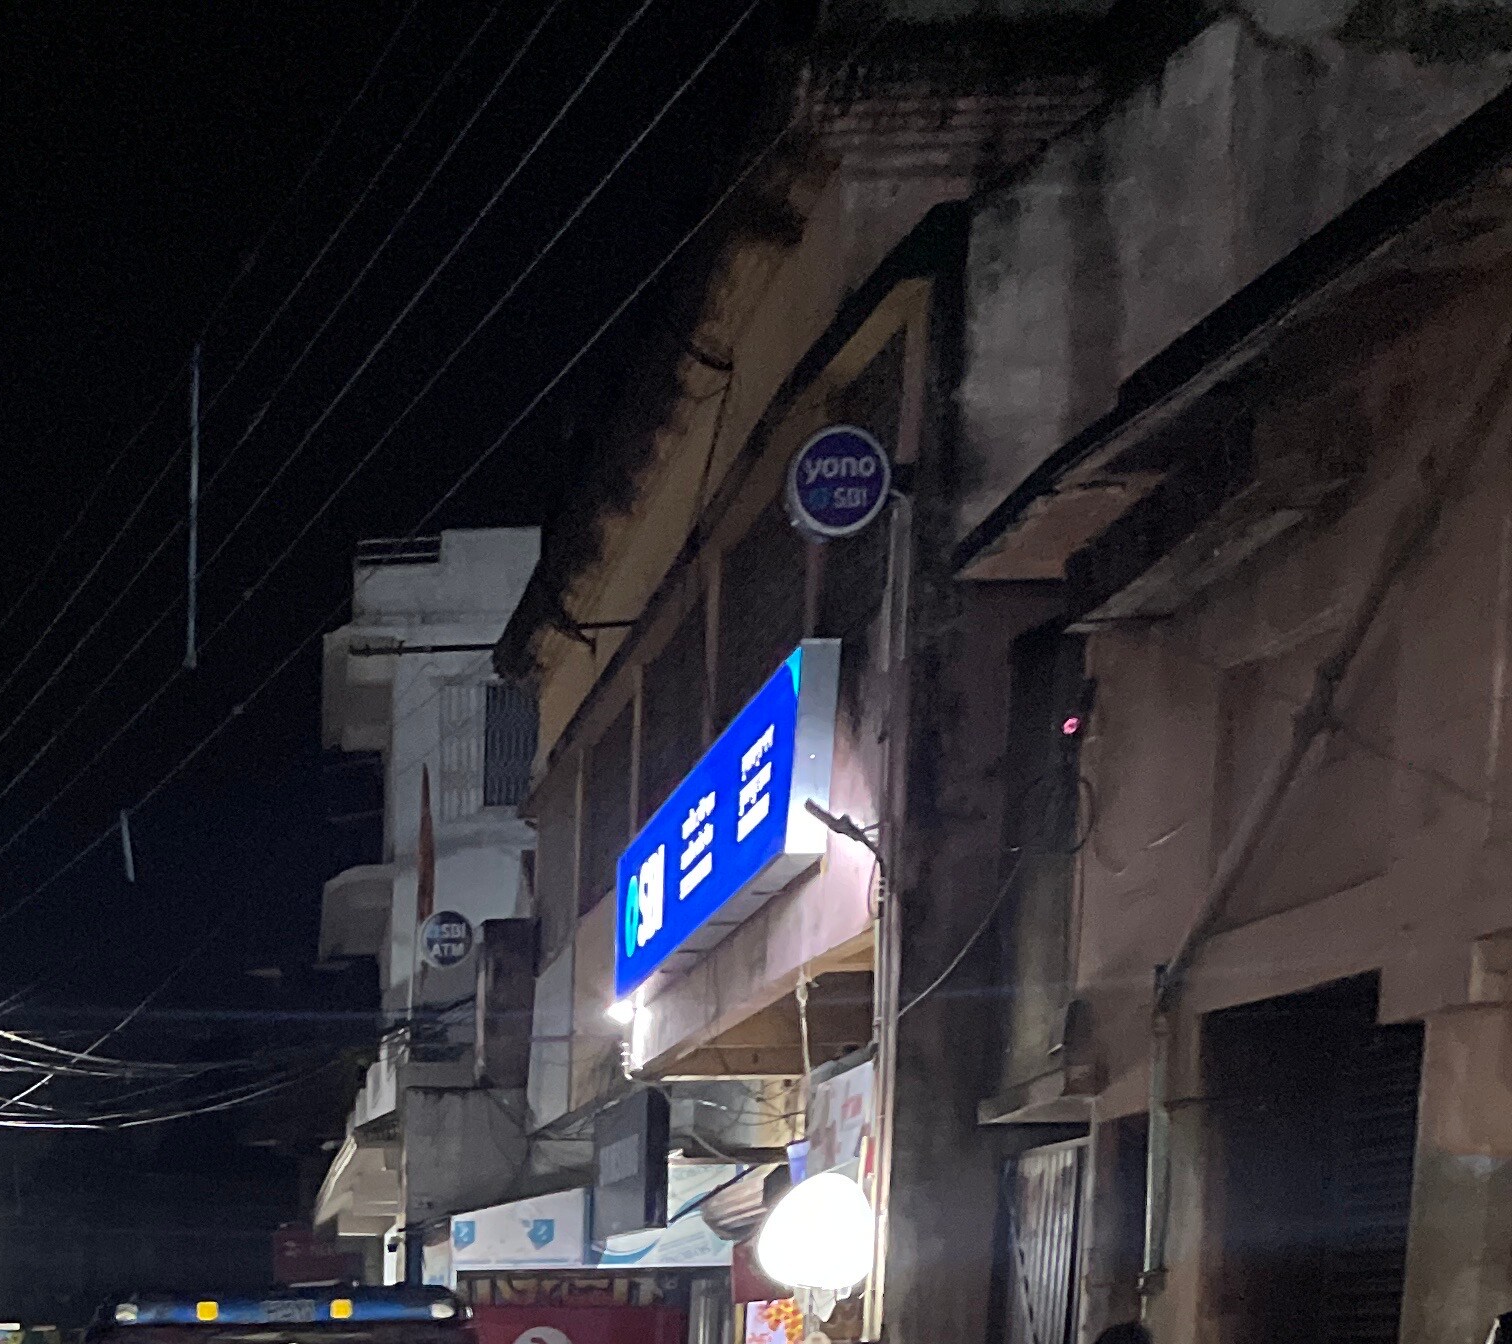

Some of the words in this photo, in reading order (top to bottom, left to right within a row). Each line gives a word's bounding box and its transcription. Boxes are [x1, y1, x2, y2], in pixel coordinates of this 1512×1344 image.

[804, 455, 876, 485] yono
[833, 486, 868, 509] SBI
[637, 844, 665, 947] SBI
[440, 923, 466, 939] SBI
[429, 943, 465, 960] ATM
